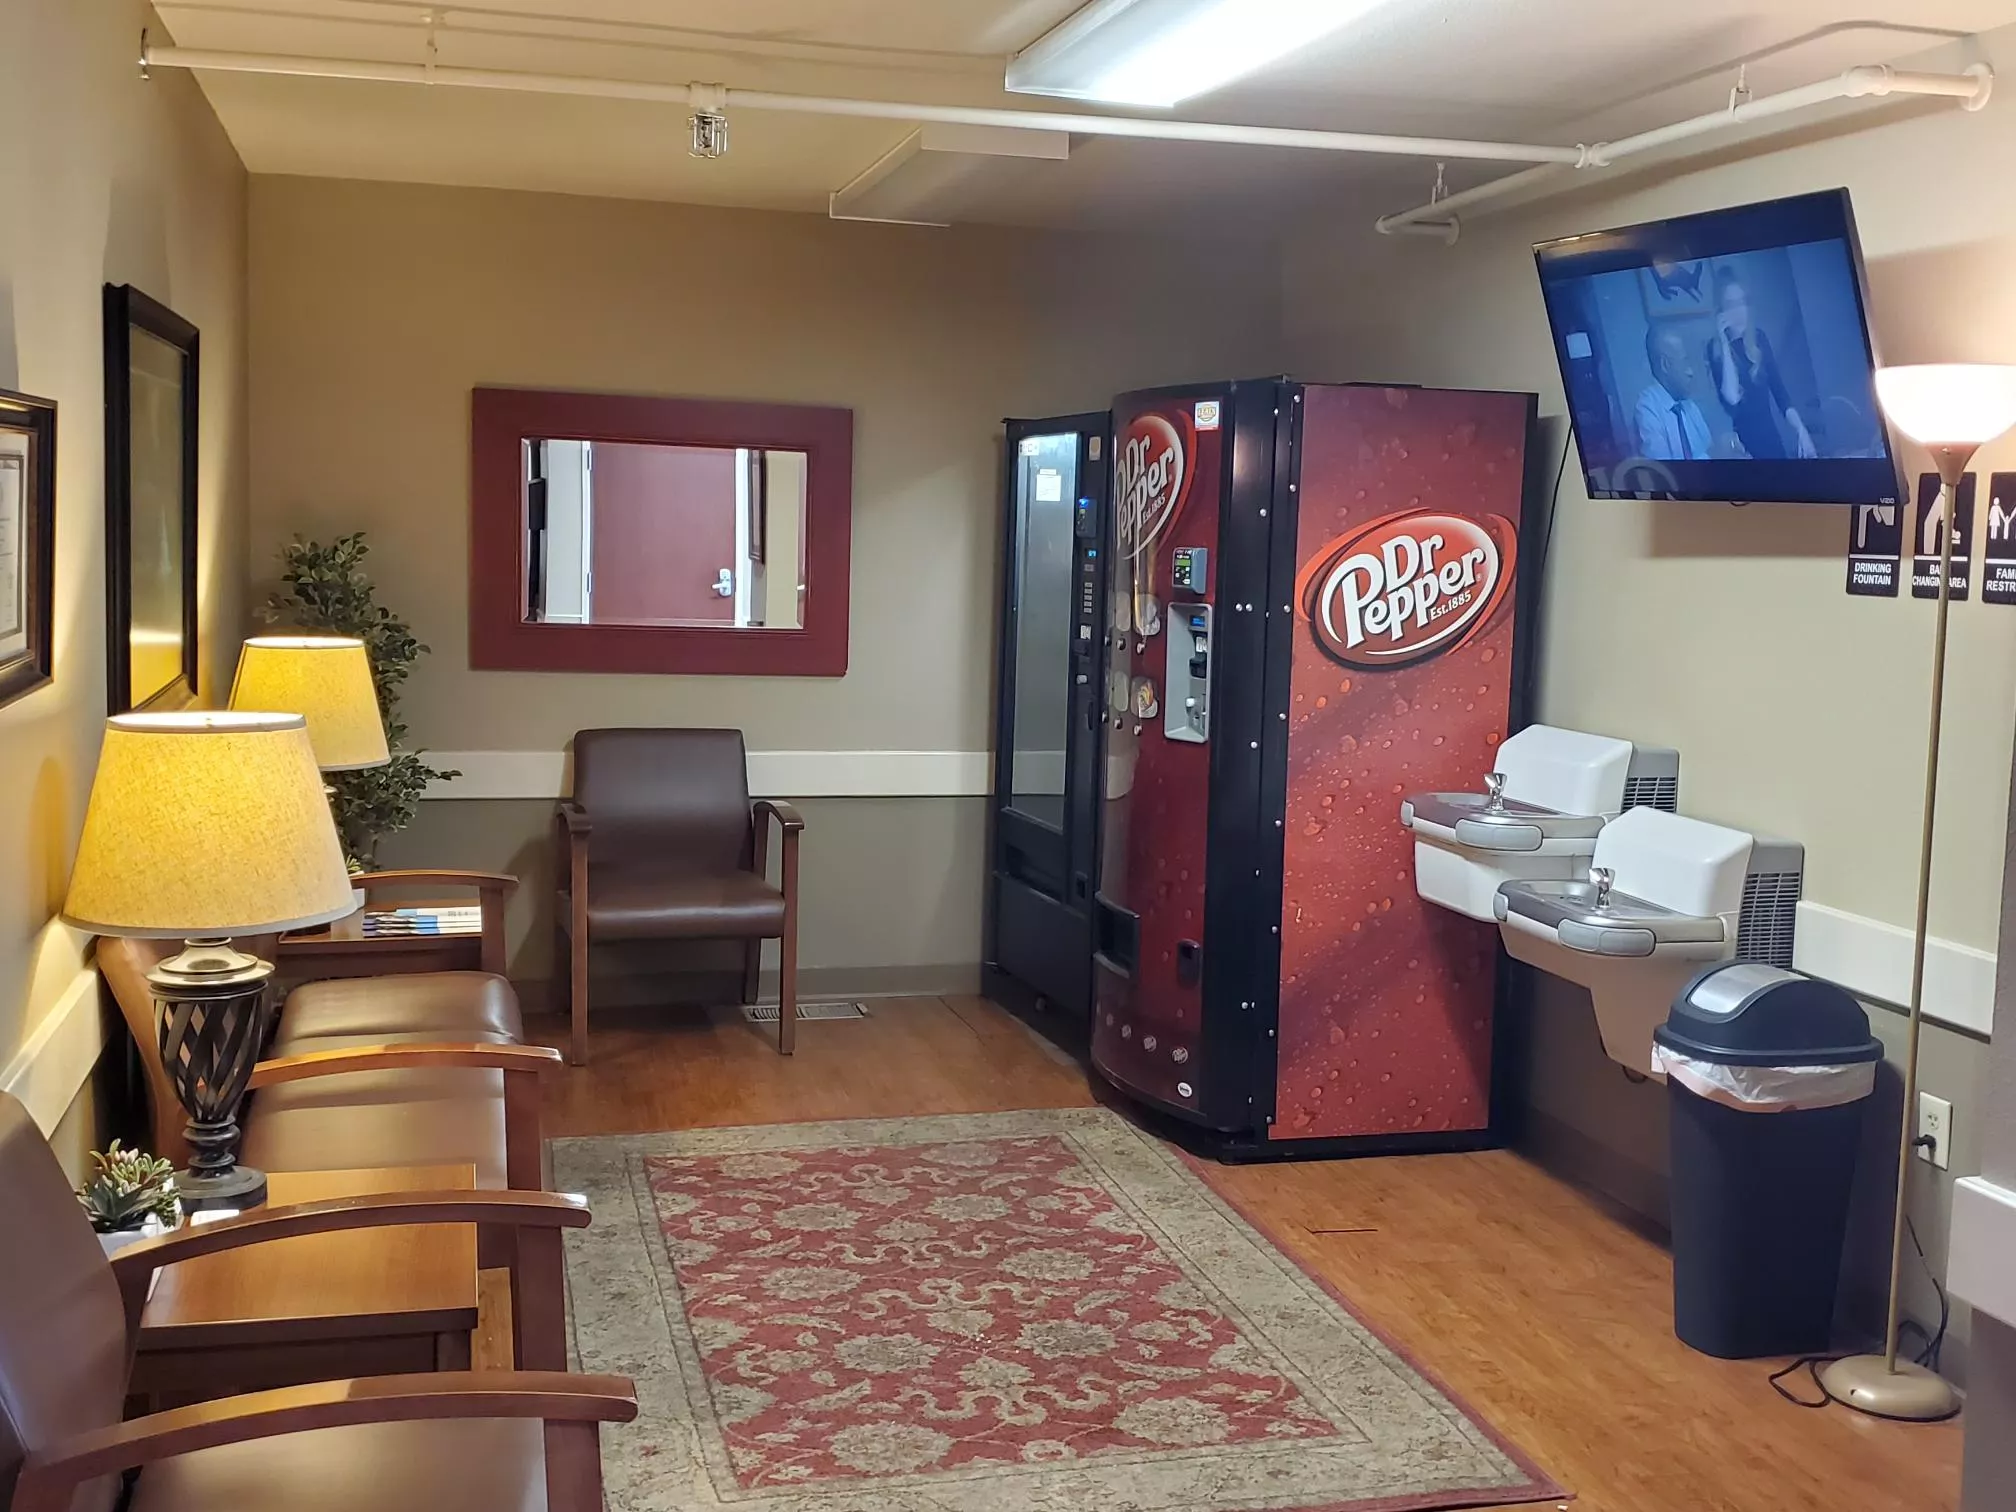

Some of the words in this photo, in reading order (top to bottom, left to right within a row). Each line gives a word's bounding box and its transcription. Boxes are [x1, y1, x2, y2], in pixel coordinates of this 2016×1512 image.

[1125, 434, 1151, 493] Dr
[1115, 447, 1174, 551] Pepper
[1380, 534, 1444, 593] Dr
[1853, 573, 1892, 585] FOUNTAIN
[1854, 562, 1892, 573] DRINKING
[1912, 575, 1941, 587] CHANGIN
[1321, 548, 1486, 649] Pepper
